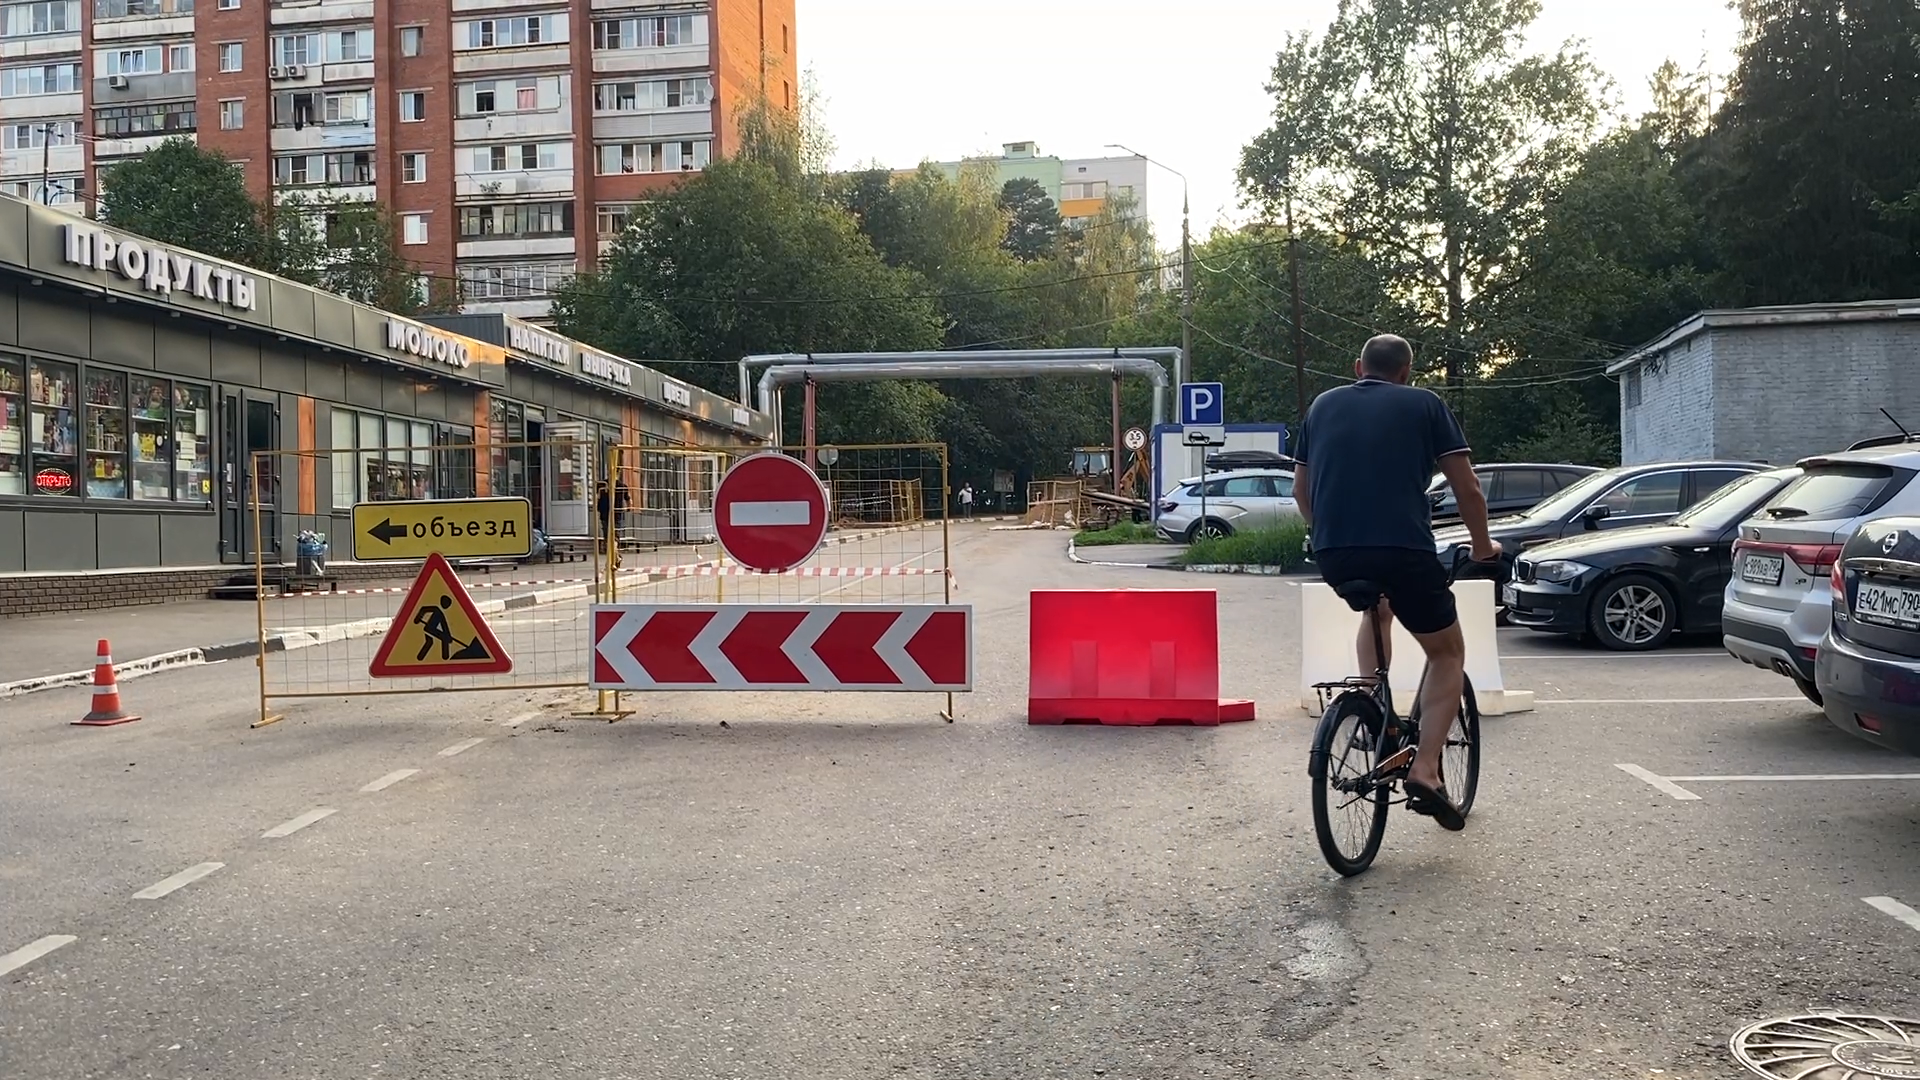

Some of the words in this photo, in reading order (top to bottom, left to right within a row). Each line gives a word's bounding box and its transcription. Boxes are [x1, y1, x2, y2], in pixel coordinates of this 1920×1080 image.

[66, 224, 256, 311] ПРОДУКТЫ
[388, 320, 470, 369] МОЛОКО
[511, 326, 570, 366] НАПИТКИ
[582, 352, 631, 387] ВЫПЕЧКА
[1191, 388, 1214, 421] P
[36, 474, 72, 488] ОТКРЫТО
[412, 516, 517, 538] объезд
[1902, 592, 1919, 611] 790
